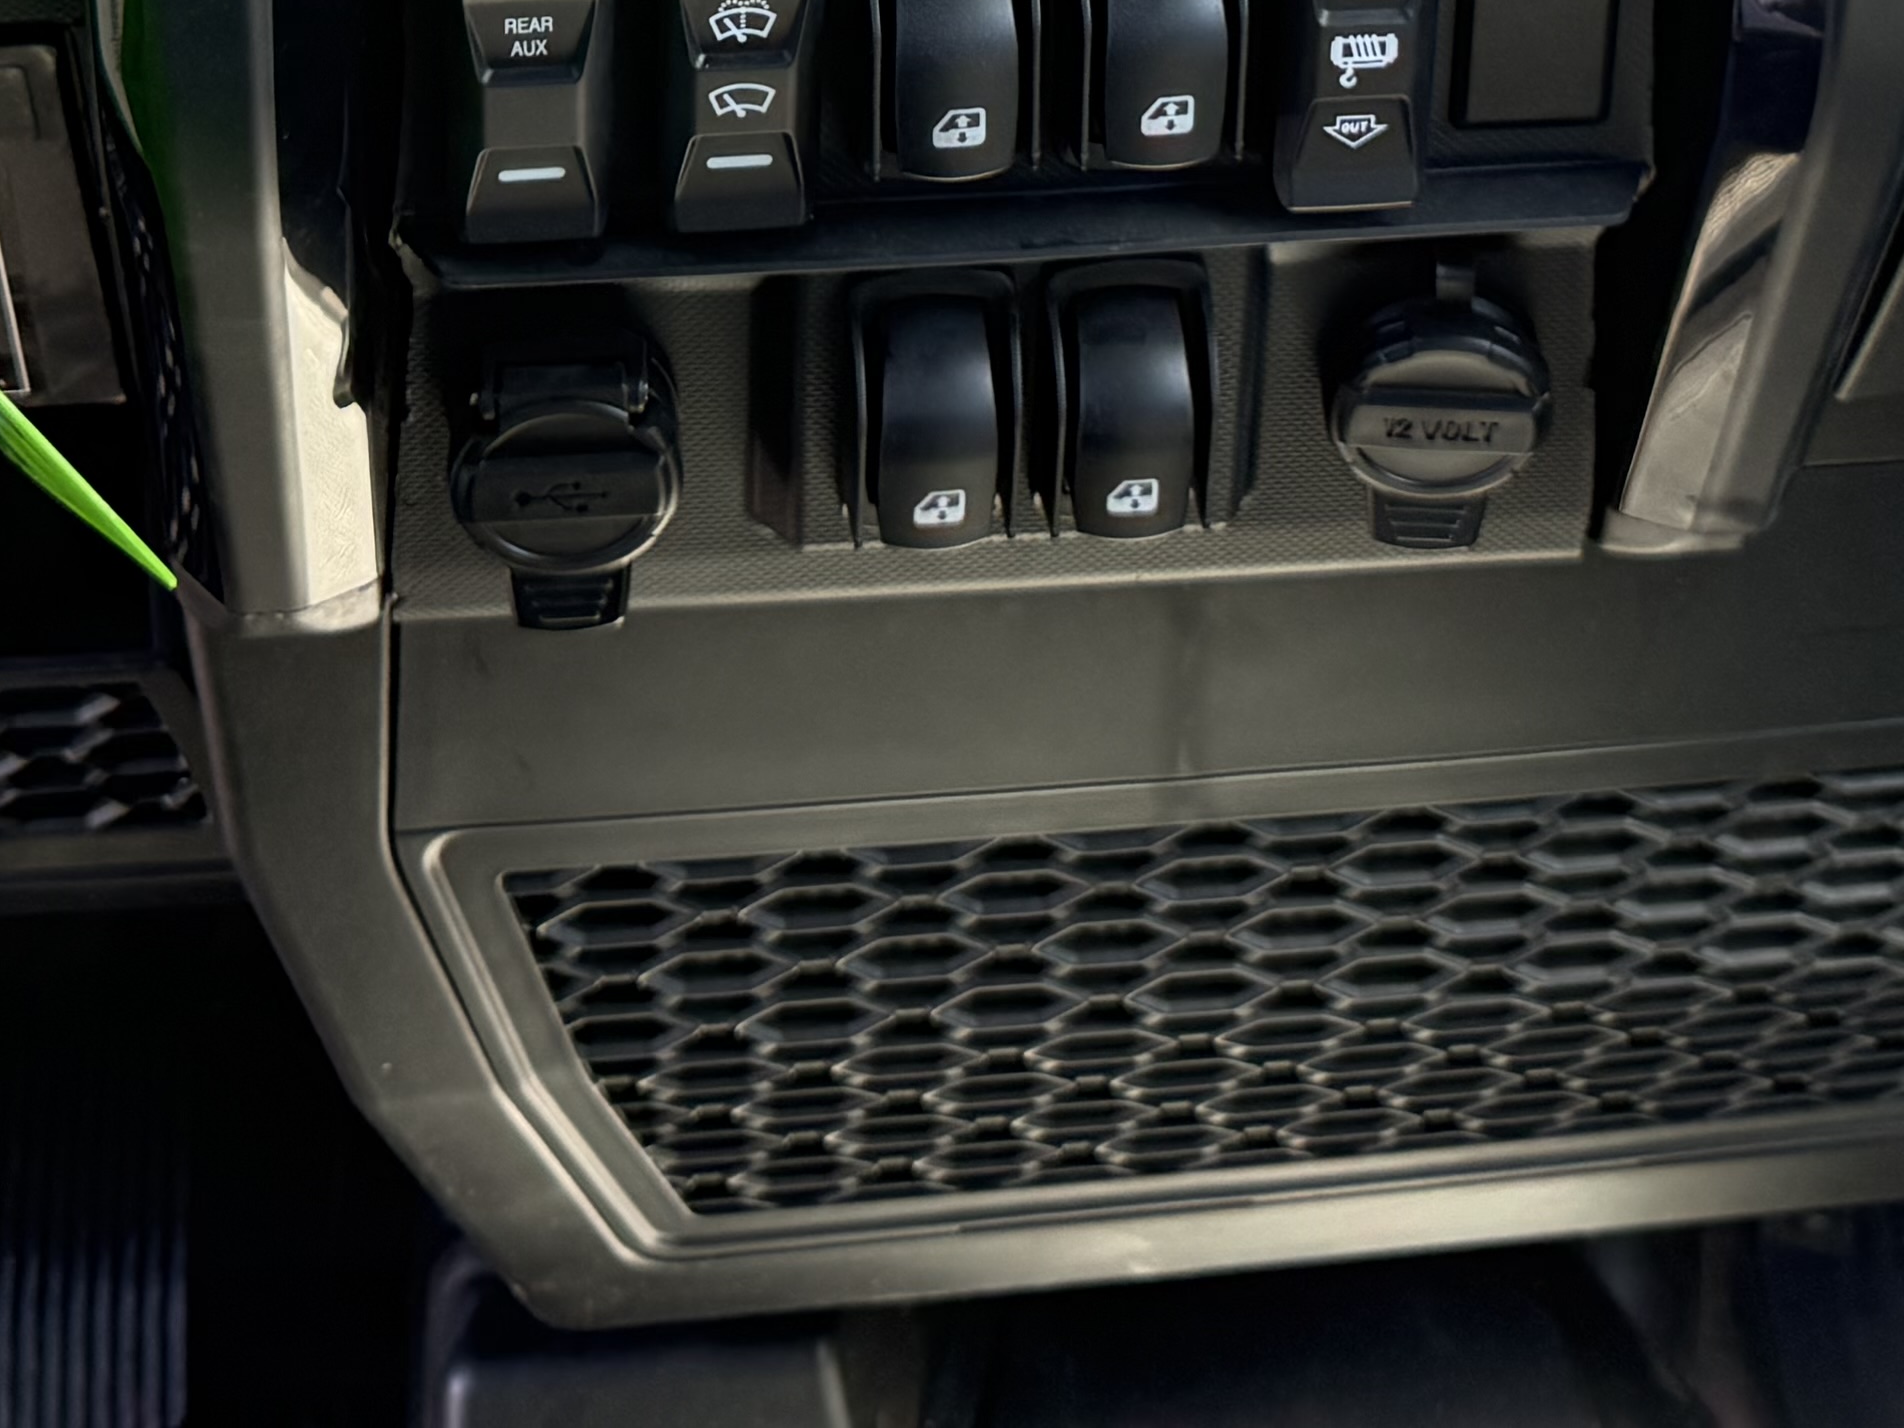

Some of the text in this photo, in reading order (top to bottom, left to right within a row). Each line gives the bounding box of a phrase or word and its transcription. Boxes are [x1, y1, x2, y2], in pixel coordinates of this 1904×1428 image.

[504, 16, 554, 38] REAR
[511, 38, 547, 58] AUX
[1338, 120, 1373, 136] OUT
[1383, 416, 1503, 446] 12 VOLT
